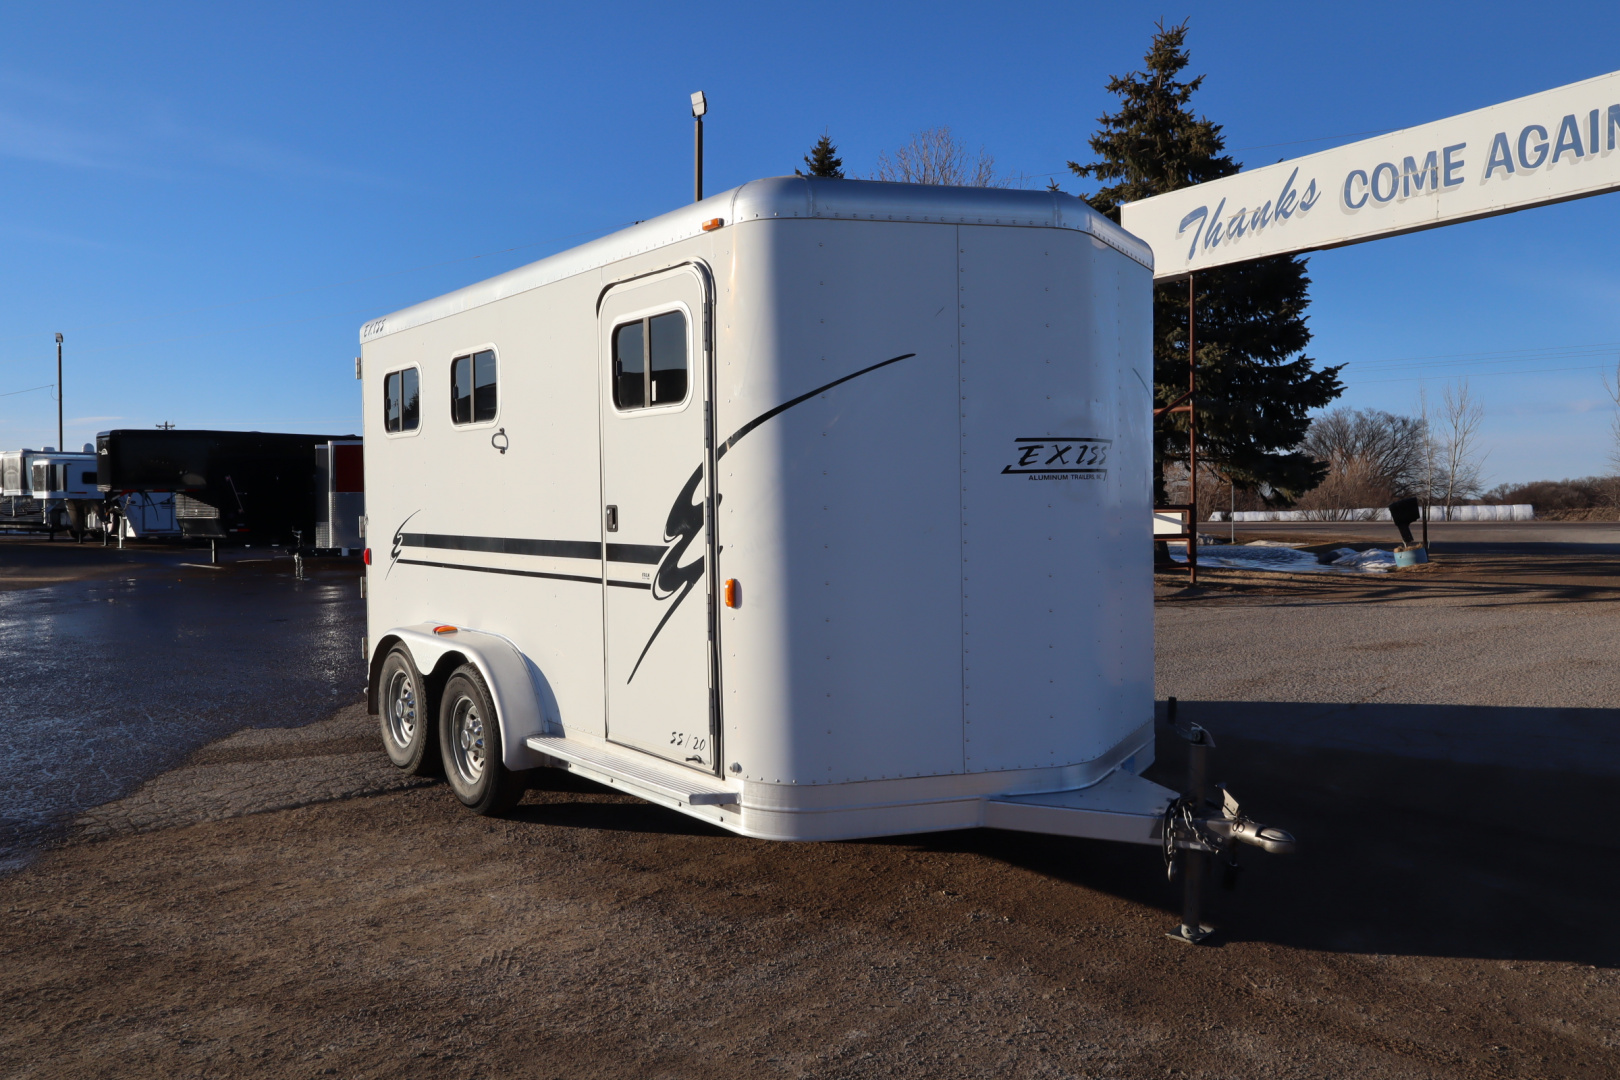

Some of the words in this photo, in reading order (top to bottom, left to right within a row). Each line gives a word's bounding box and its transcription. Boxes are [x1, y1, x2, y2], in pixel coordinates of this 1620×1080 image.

[1178, 166, 1322, 261] Thanks
[1343, 142, 1467, 209] COME
[1017, 444, 1107, 466] EXISS
